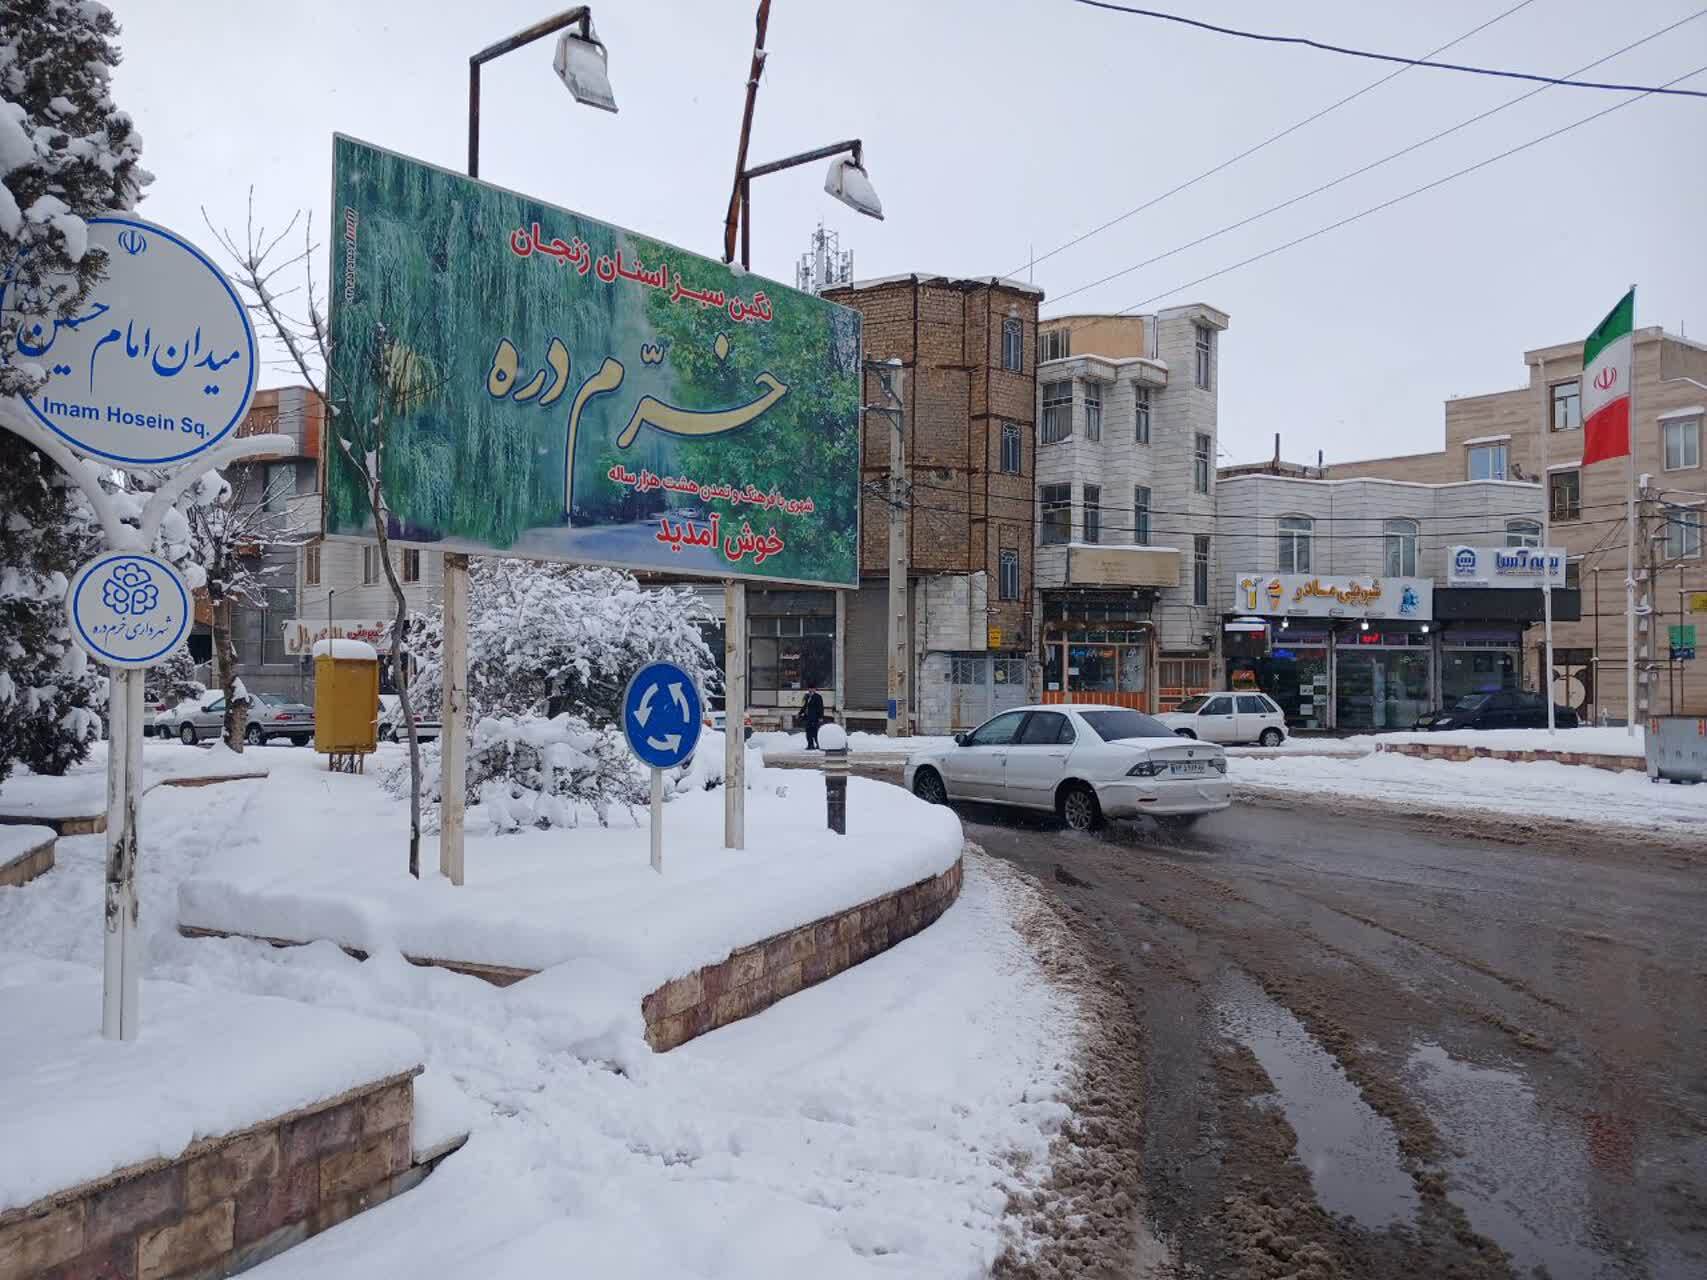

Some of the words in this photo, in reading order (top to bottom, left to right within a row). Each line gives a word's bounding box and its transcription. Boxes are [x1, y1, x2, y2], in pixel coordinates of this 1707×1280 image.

[510, 223, 592, 275] زنجان
[595, 251, 669, 289] استان
[671, 273, 725, 308] سبز
[728, 291, 773, 322] نگین
[16, 302, 110, 376] حسین
[90, 319, 151, 396] امام
[152, 326, 240, 394] میدان
[487, 337, 570, 405] دره
[43, 396, 100, 420] Imam
[107, 406, 175, 431] Hosein
[180, 416, 210, 439] Sq.
[608, 464, 637, 485] ساله
[636, 468, 661, 491] هزار
[662, 475, 699, 494] هشت
[700, 483, 731, 501] تمدن
[732, 487, 740, 505] و
[740, 484, 778, 510] فرهنگ
[786, 496, 815, 515] شهری
[655, 513, 720, 551] آمدید
[724, 522, 784, 564] خوش
[125, 615, 172, 640] شهرداری
